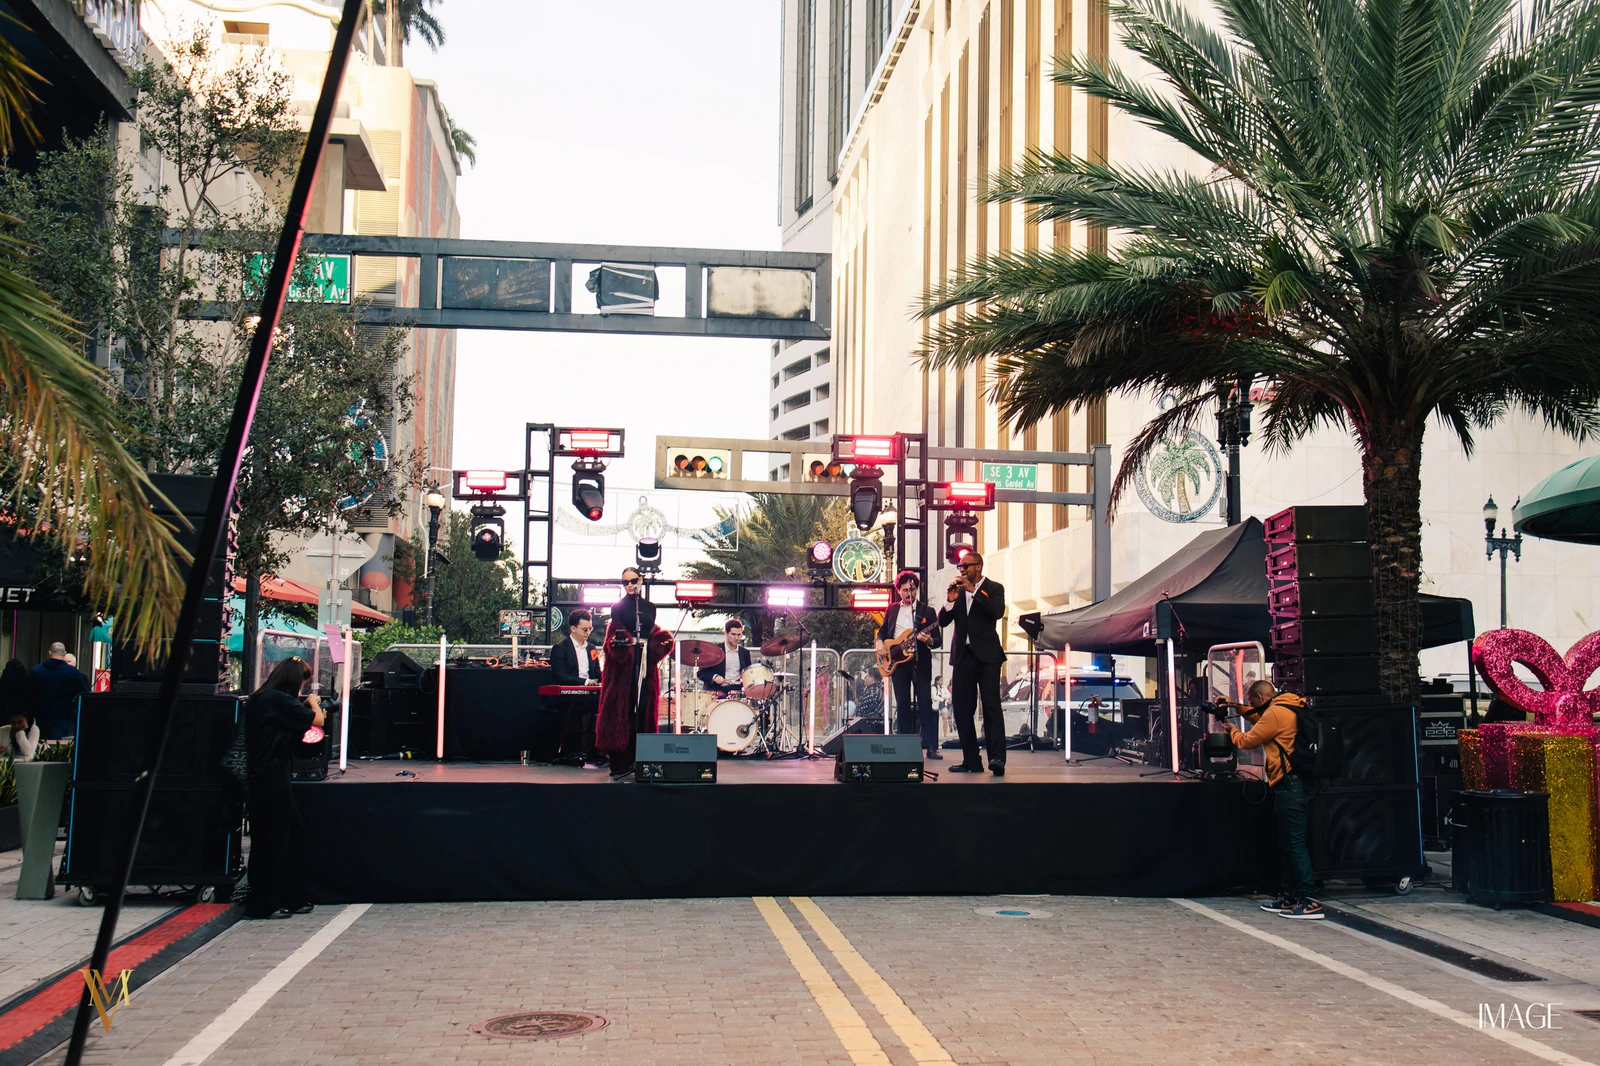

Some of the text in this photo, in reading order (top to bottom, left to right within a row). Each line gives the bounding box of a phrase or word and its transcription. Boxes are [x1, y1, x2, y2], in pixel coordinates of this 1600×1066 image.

[990, 466, 1029, 478] SE 3 AV
[1005, 479, 1023, 488] Gardel
